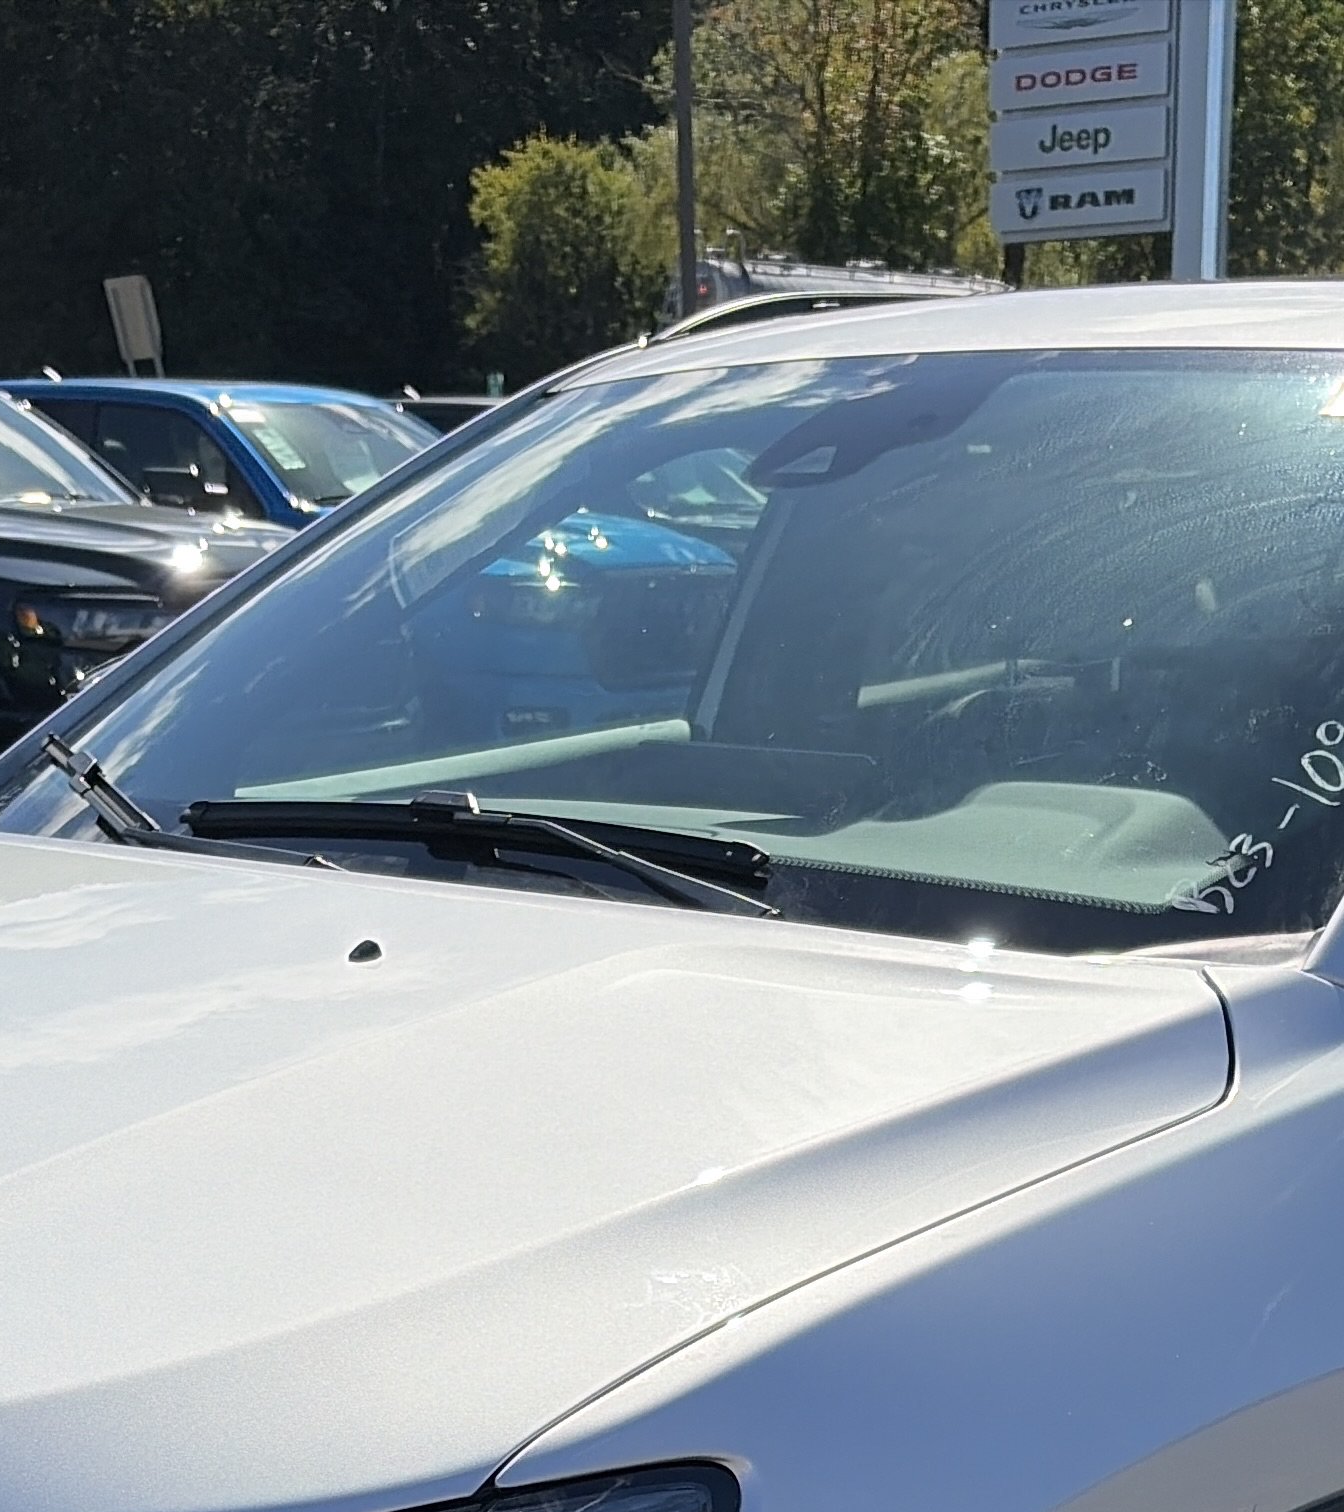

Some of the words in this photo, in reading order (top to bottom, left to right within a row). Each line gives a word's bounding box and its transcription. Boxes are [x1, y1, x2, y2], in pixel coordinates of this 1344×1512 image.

[1015, 63, 1138, 91] DODGE
[1039, 124, 1111, 155] Jeep
[1049, 188, 1135, 210] RAM
